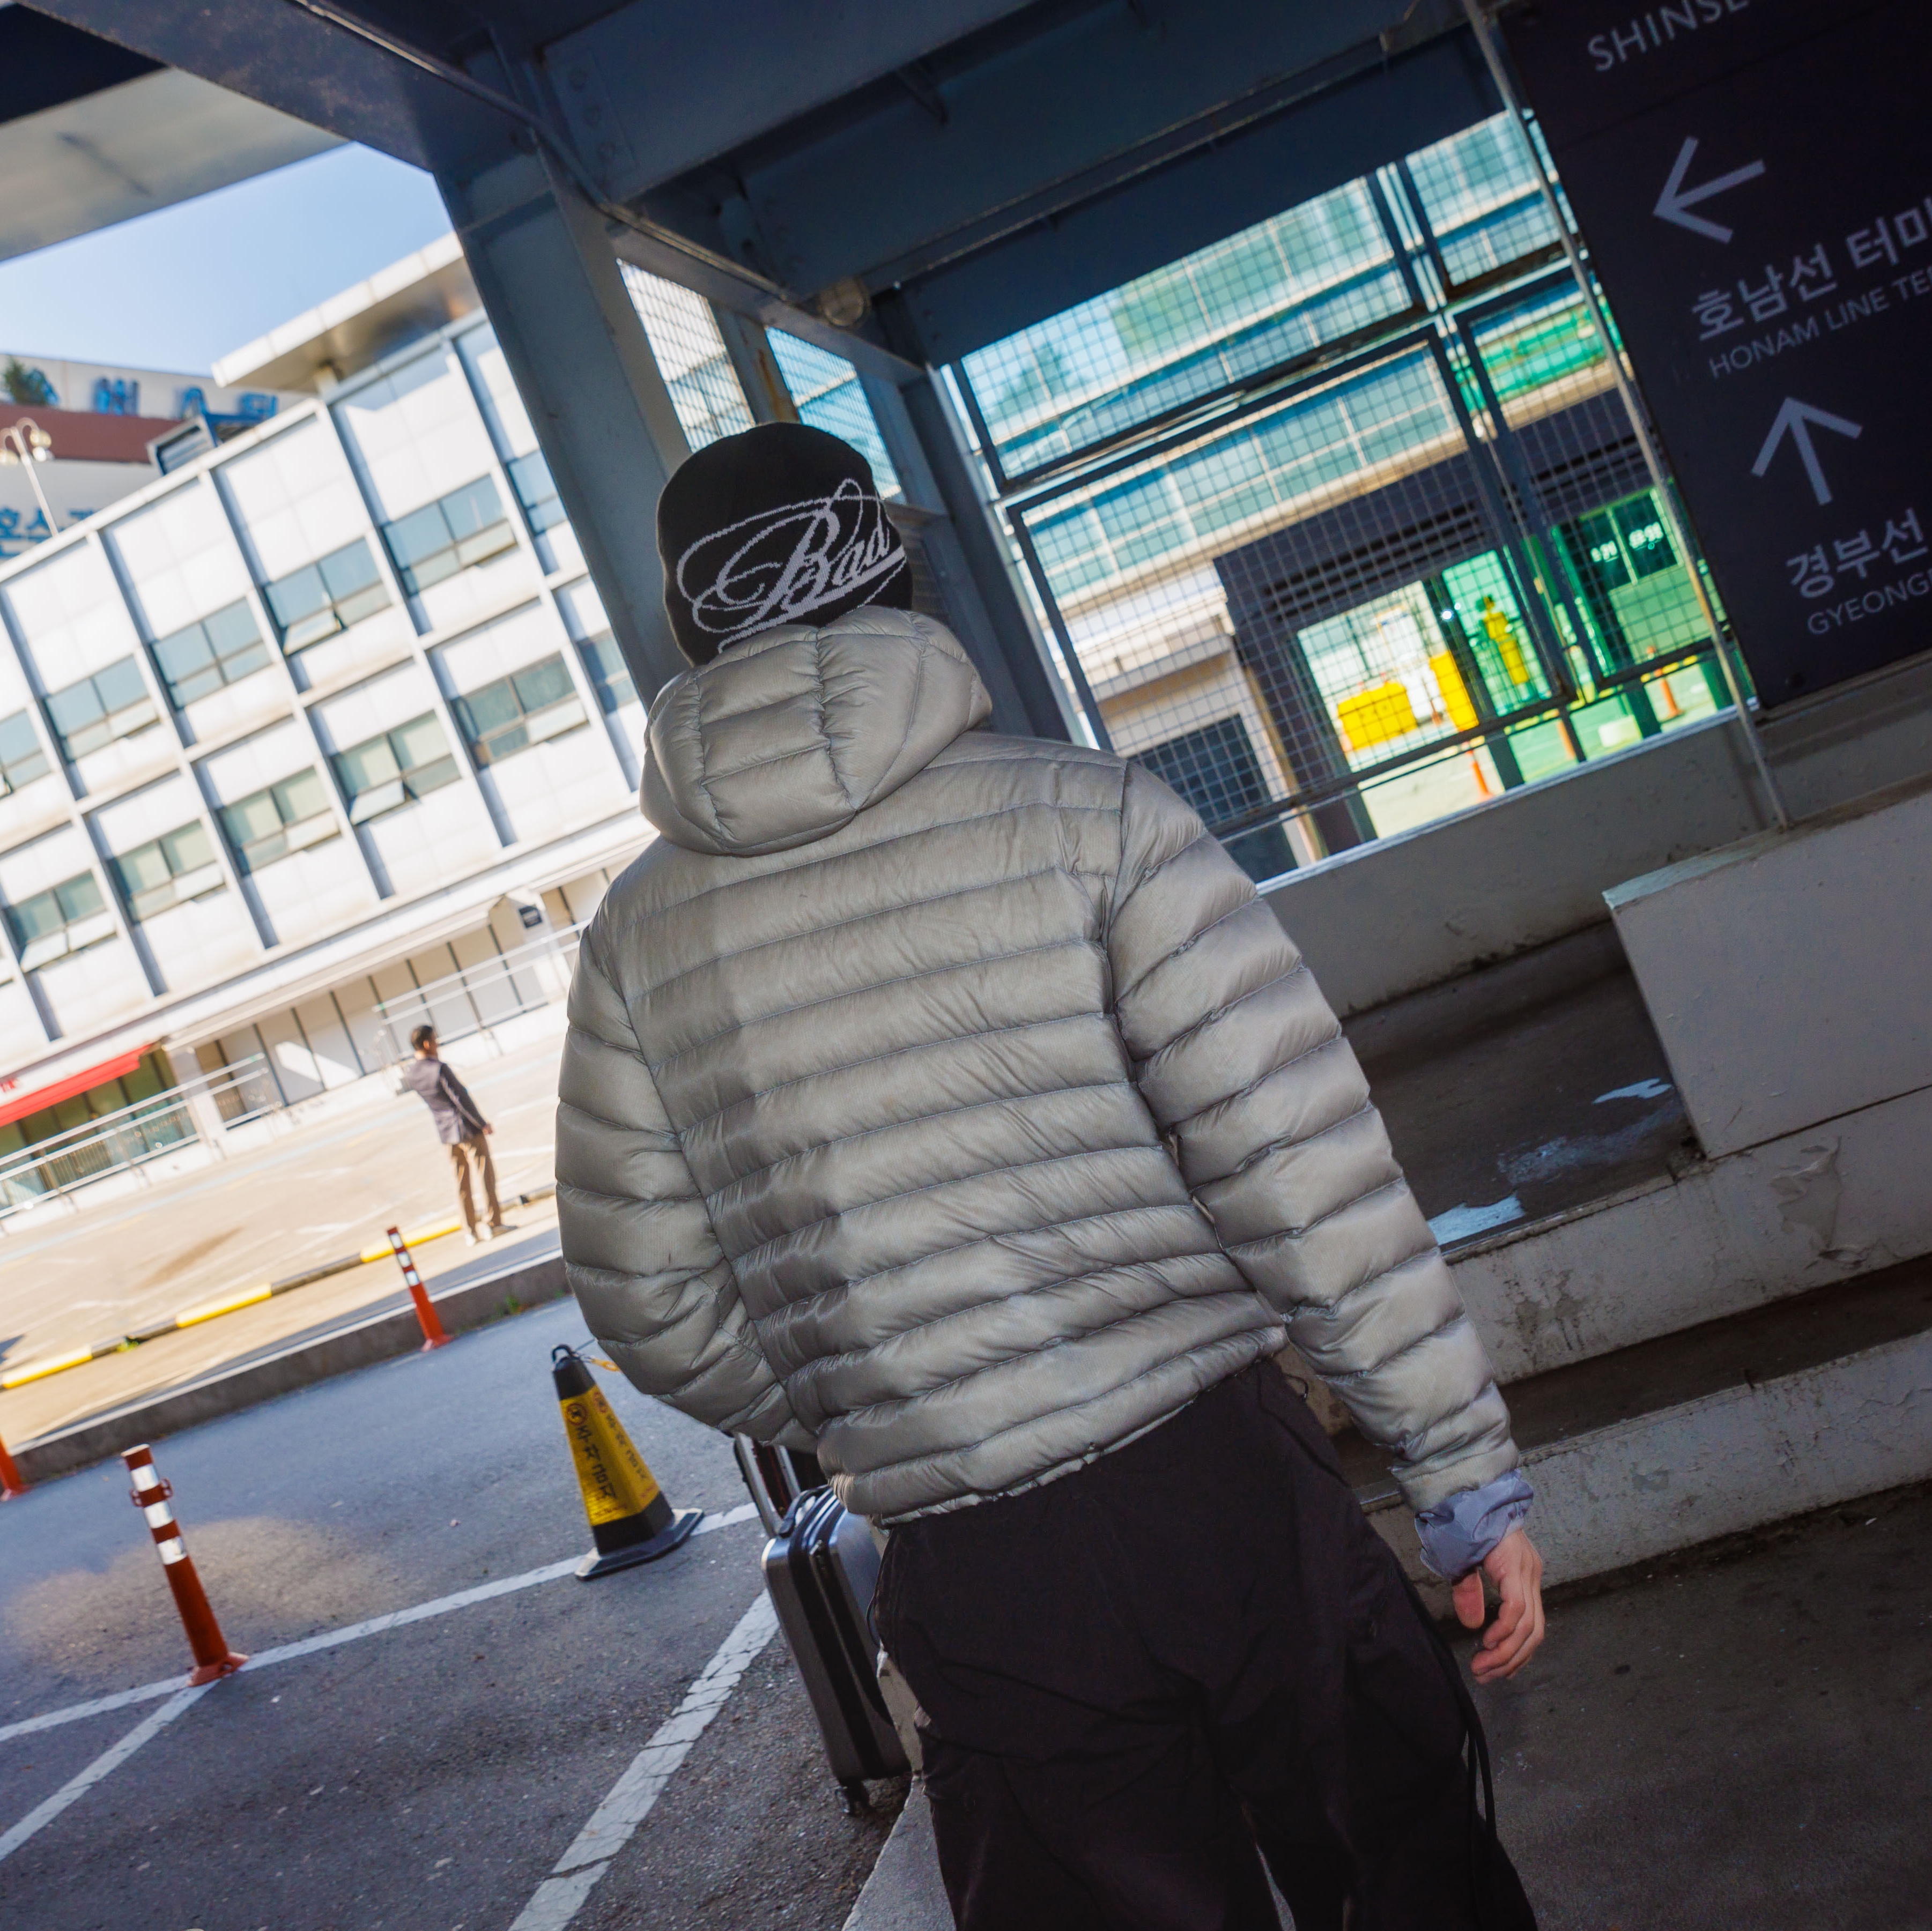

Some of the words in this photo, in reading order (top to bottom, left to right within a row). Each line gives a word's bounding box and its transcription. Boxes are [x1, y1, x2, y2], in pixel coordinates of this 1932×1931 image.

[1692, 242, 1838, 341] 호남선
[1708, 315, 1819, 379] HONAM
[1825, 287, 1890, 331] LINE
[1891, 266, 1932, 301] TE
[1787, 507, 1929, 598] 경부선
[1807, 567, 1932, 635] GYEONG
